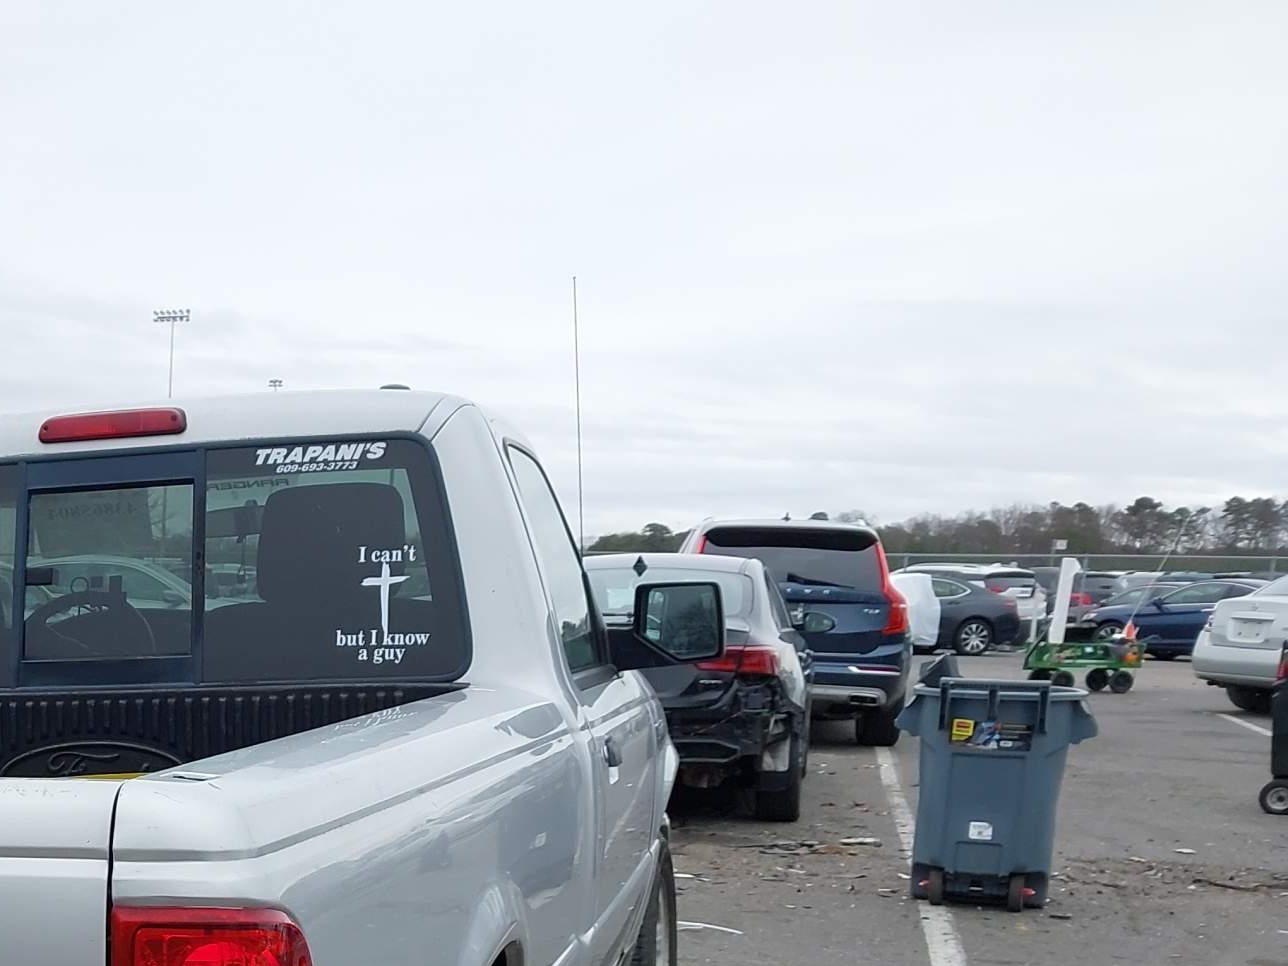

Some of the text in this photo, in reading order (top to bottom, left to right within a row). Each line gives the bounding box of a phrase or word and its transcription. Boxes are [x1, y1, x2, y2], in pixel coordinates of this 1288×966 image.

[255, 442, 387, 465] TRAPANI'S
[276, 461, 358, 473] 609-693-3773
[358, 544, 417, 563] I can't
[336, 629, 430, 646] but I know
[358, 647, 406, 664] a guy
